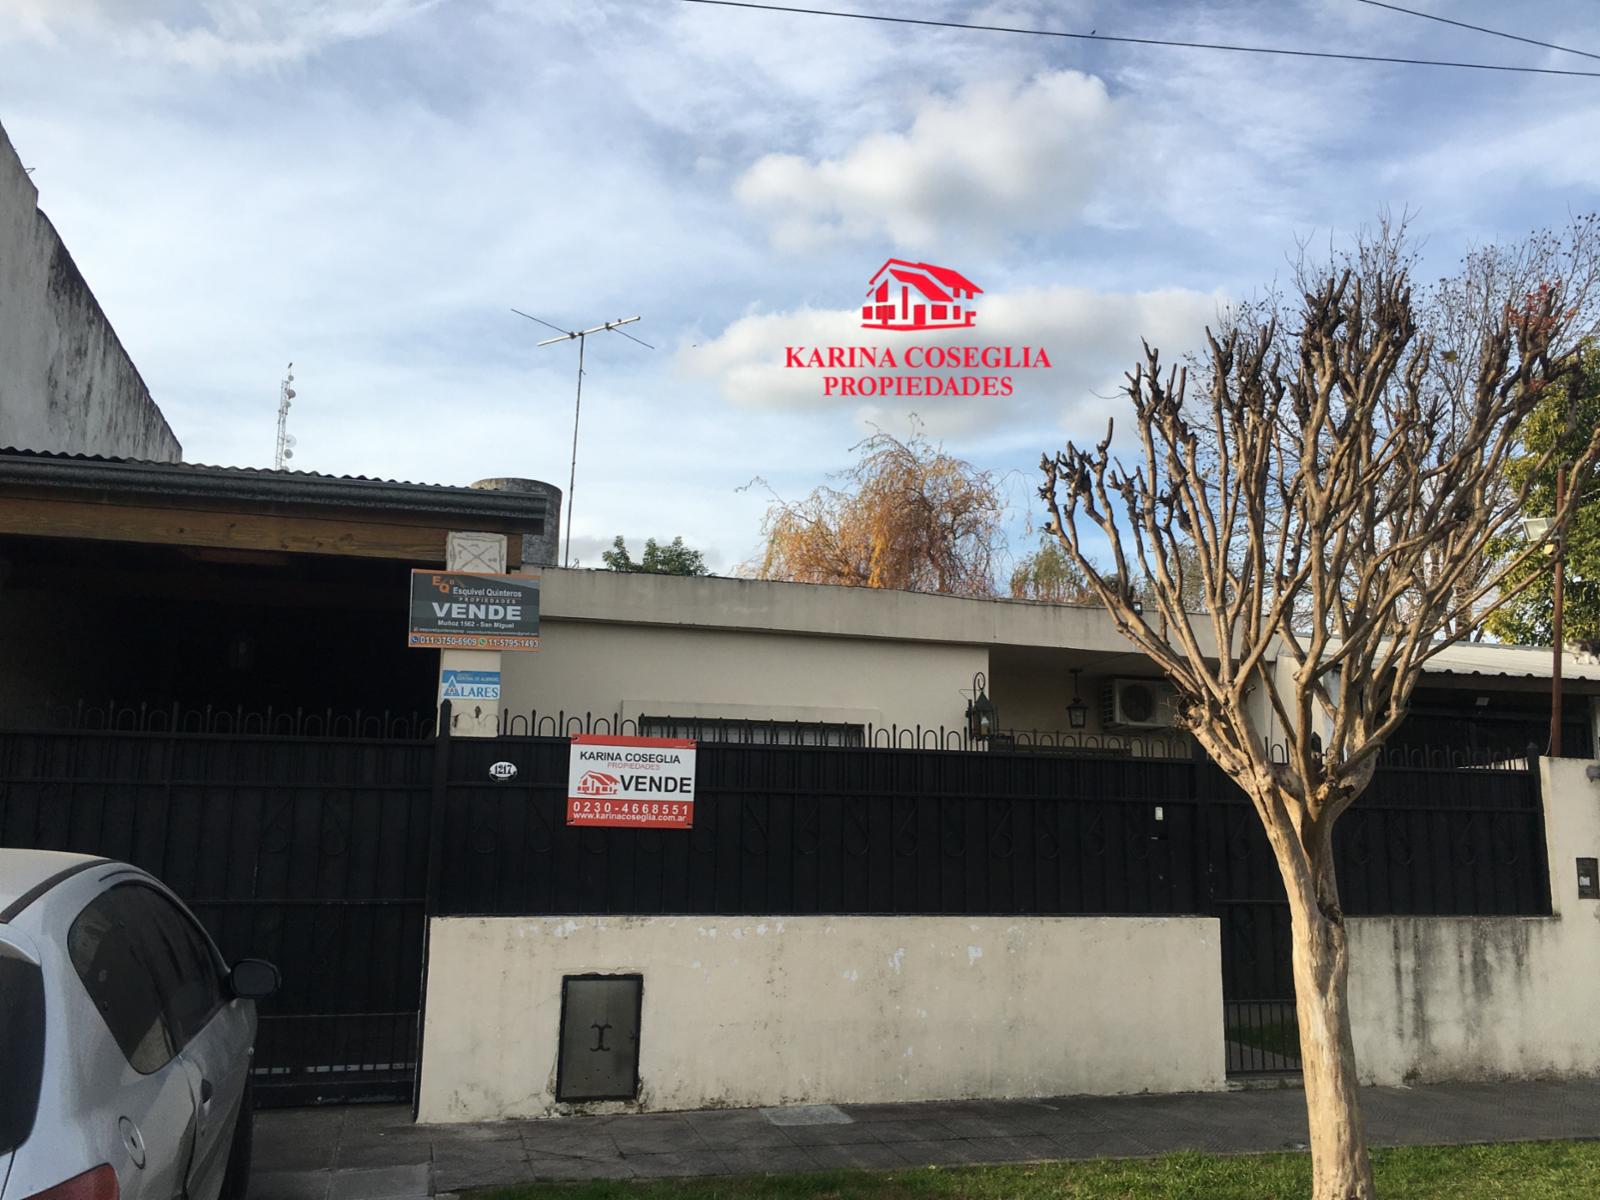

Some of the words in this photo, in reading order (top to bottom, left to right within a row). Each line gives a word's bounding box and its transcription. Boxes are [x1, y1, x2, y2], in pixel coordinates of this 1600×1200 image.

[452, 587, 485, 597] Esquivel
[486, 588, 522, 598] Quinteros
[432, 602, 522, 621] VENDE
[580, 751, 622, 761] KARINA
[625, 753, 681, 764] COSEGLIA
[494, 763, 512, 775] 1217
[607, 762, 661, 771] PROPIEDADES
[619, 775, 692, 793] VENDE
[573, 811, 687, 822] www.karinacoseglia.com.ar
